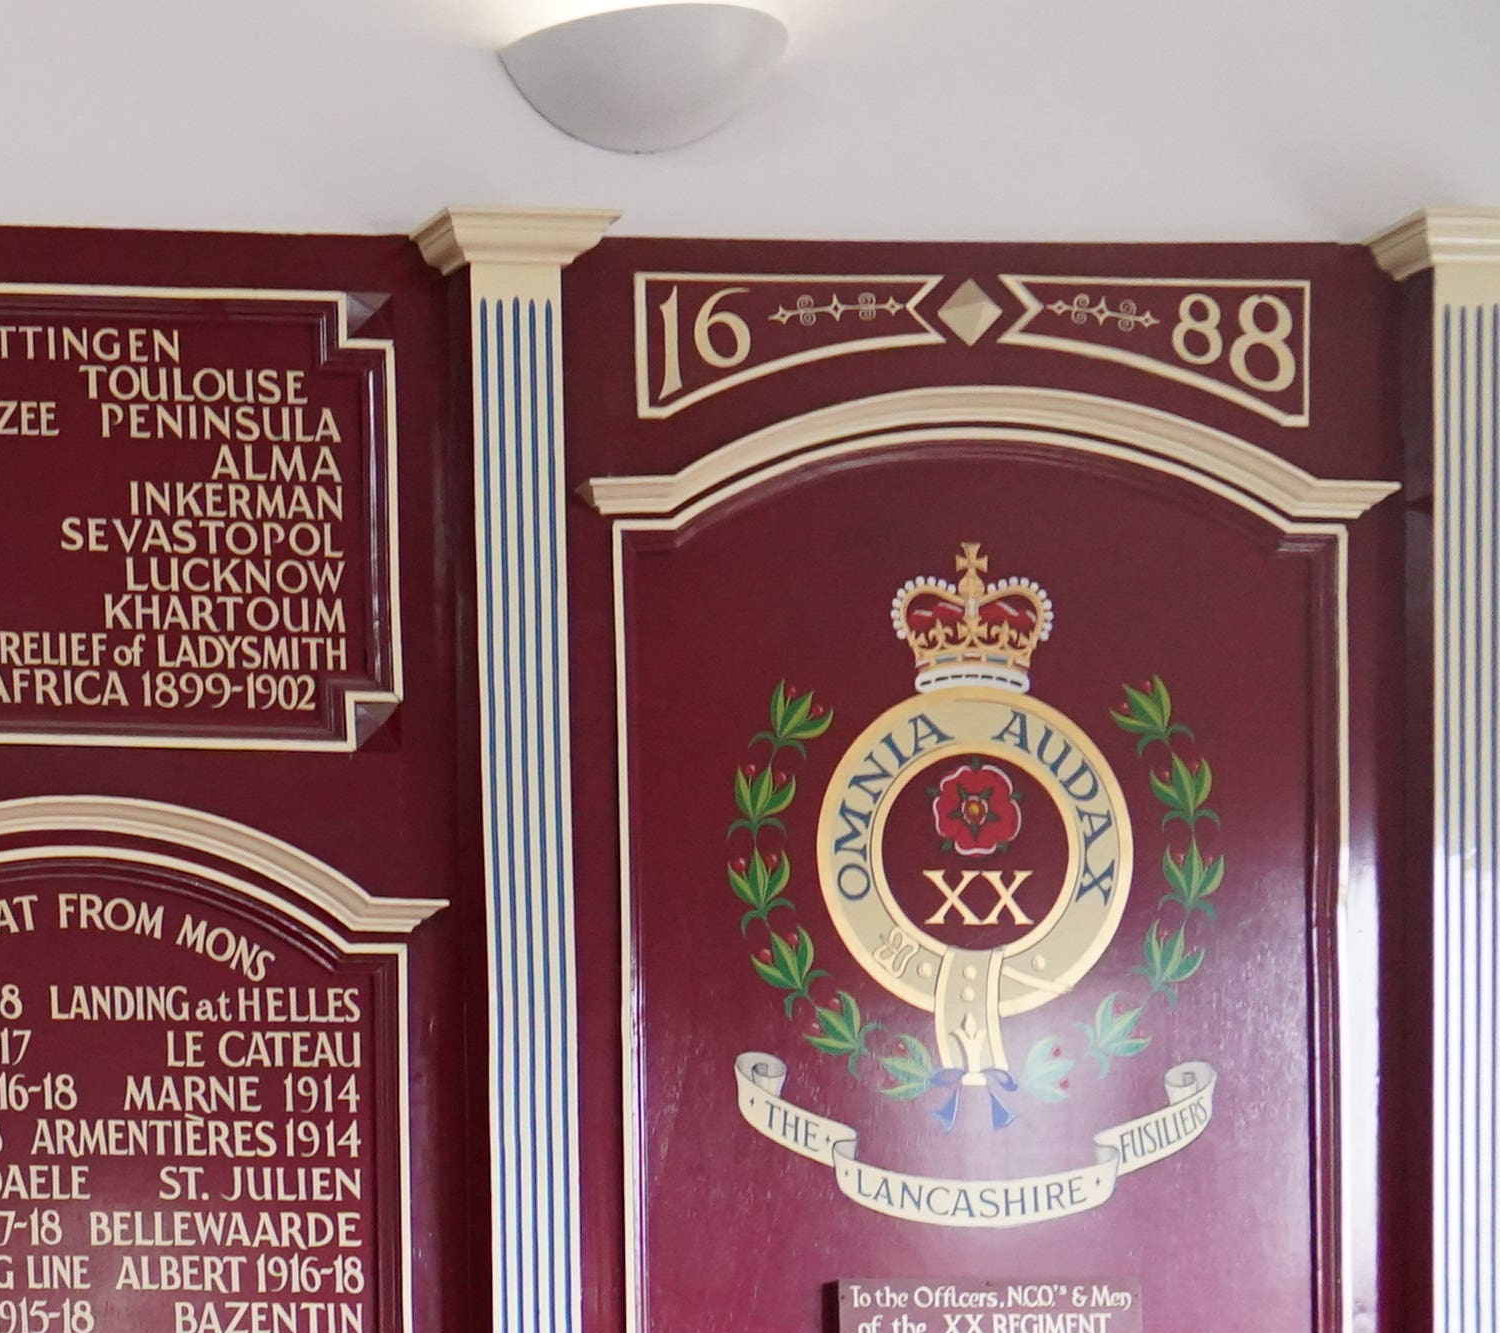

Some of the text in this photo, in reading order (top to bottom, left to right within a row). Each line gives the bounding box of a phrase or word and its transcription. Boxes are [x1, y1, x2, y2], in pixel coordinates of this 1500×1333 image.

[79, 365, 307, 404] TOULOUSE
[102, 403, 341, 442] PENINSULA
[212, 445, 341, 482] ALMA
[131, 482, 342, 520] INKERMAN
[61, 518, 343, 557] SEVASTOPOL
[126, 557, 344, 594] LUCKNOW
[105, 594, 345, 632] KHARTOUM
[0, 632, 346, 670] RELIEF of LADYSMITH
[832, 709, 1116, 908] OMNIA AUDAX
[923, 869, 1033, 925] XX
[59, 894, 164, 939] FROM
[176, 915, 275, 981] MONS
[50, 986, 360, 1022] LANDING at HELLES
[167, 1031, 360, 1067] LE CATEAU
[124, 1073, 359, 1113] MARNE 1914
[286, 1119, 361, 1157] 1914
[764, 1096, 1210, 1220] THE LANCASHIRE FUSILIERS
[160, 1166, 360, 1201] ST. JULIEN
[90, 1211, 361, 1249] BELLEWAARDE
[27, 1256, 91, 1289] LINE
[116, 1256, 246, 1293] ALBERT
[875, 1286, 908, 1307] the
[1091, 1286, 1131, 1310] Men
